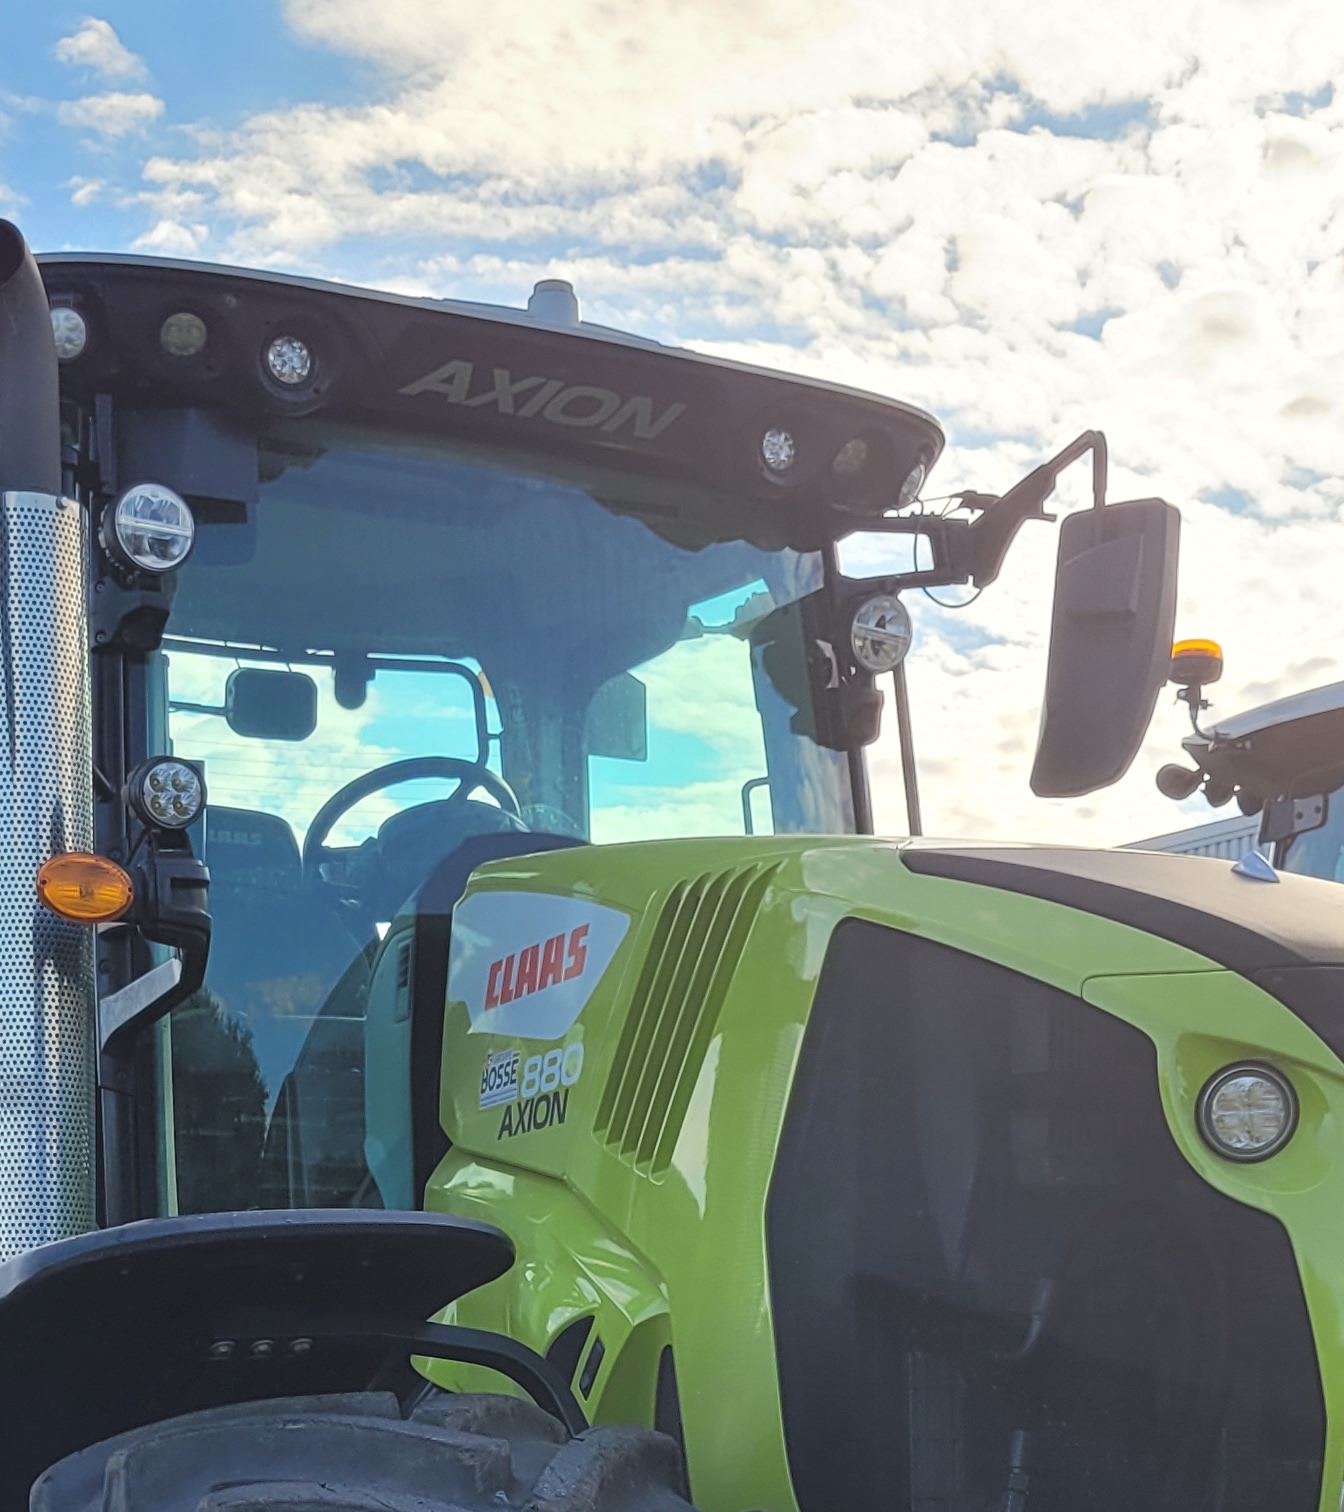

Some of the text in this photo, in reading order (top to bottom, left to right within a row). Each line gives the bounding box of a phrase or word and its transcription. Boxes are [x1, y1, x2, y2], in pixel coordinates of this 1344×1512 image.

[398, 359, 686, 439] AXION
[484, 922, 591, 1011] CLAAS
[480, 1058, 519, 1094] BOSSE
[521, 1042, 584, 1098] 880
[497, 1087, 569, 1140] AXION
